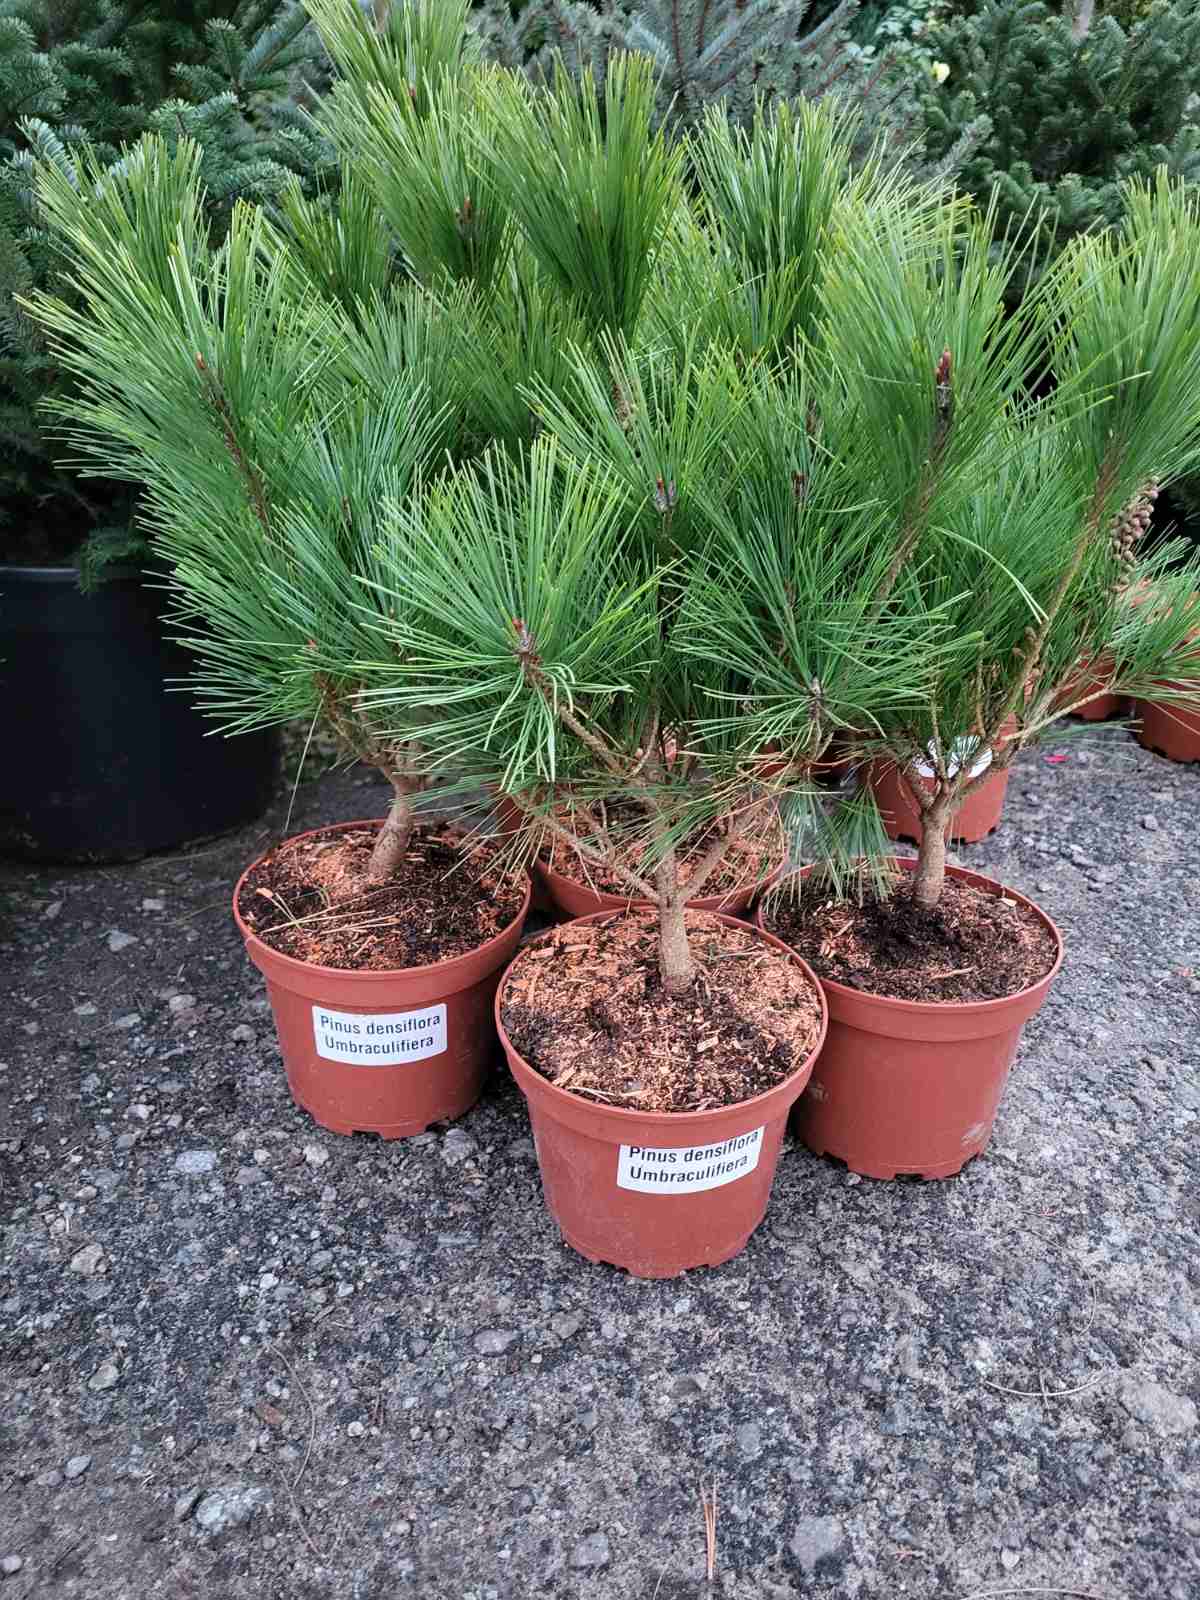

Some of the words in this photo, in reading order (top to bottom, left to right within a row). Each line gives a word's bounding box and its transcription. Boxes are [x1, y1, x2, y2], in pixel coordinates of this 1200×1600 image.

[320, 1015, 361, 1034] Pinus
[366, 1014, 441, 1035] densiflora
[325, 1035, 434, 1055] Umbraculifiera
[629, 1146, 677, 1163] Pinus
[684, 1131, 758, 1162] densiflora
[630, 1154, 748, 1183] Umbraculifiera
